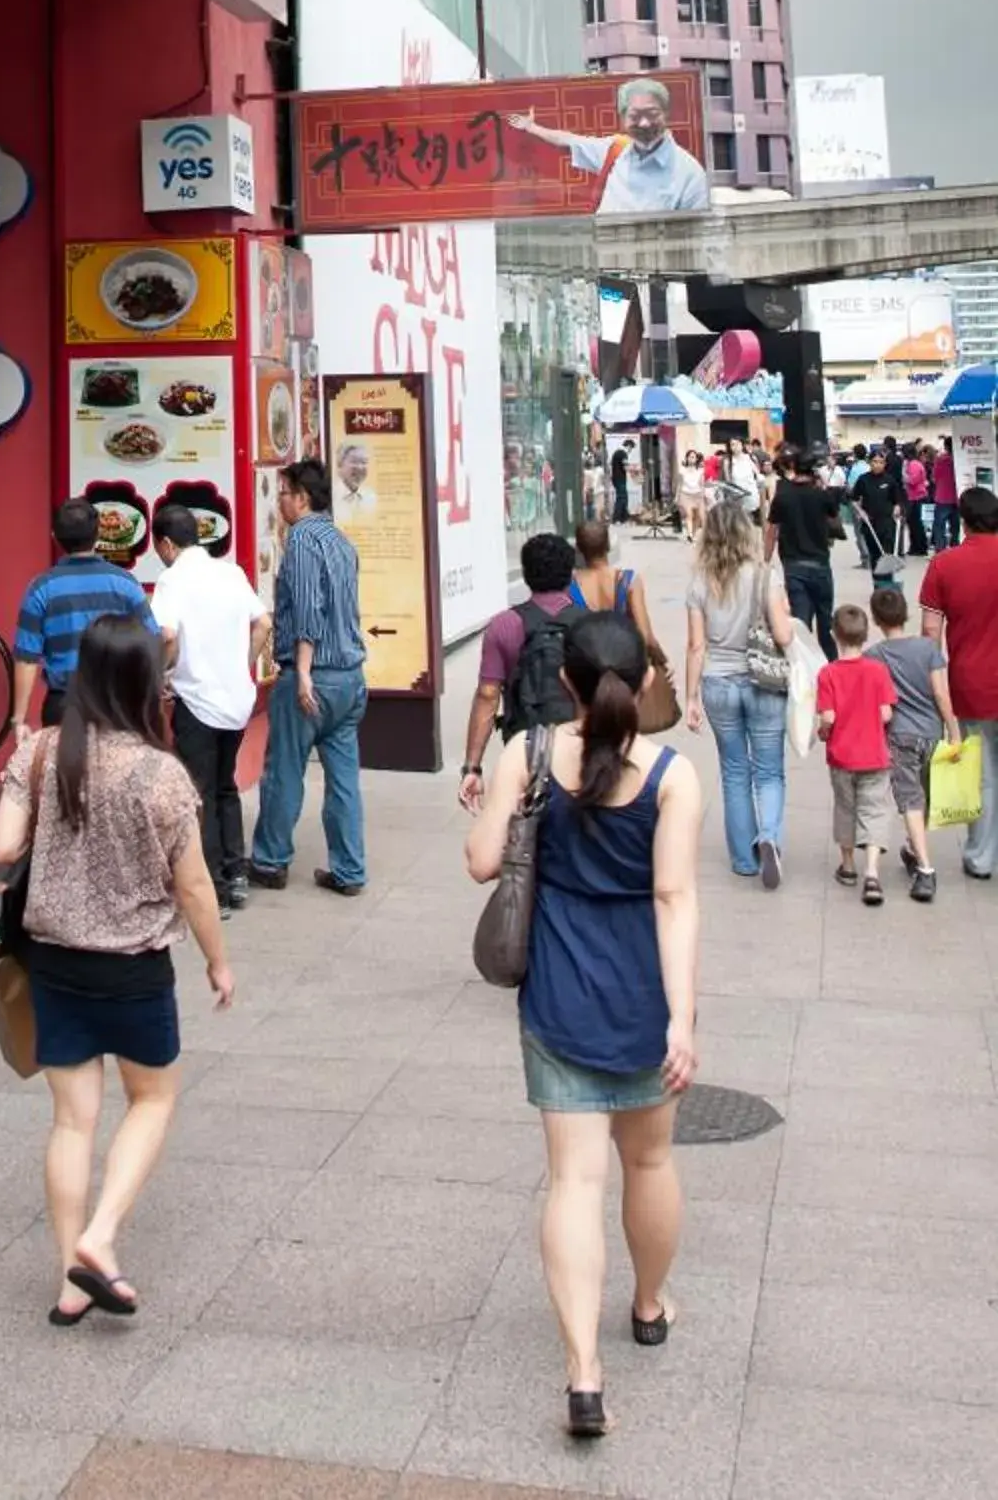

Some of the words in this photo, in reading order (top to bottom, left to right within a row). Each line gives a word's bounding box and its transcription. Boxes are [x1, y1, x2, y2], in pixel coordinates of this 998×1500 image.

[159, 157, 214, 189] yes
[178, 186, 197, 199] 4G
[821, 298, 865, 313] FREE
[870, 296, 906, 313] SMS
